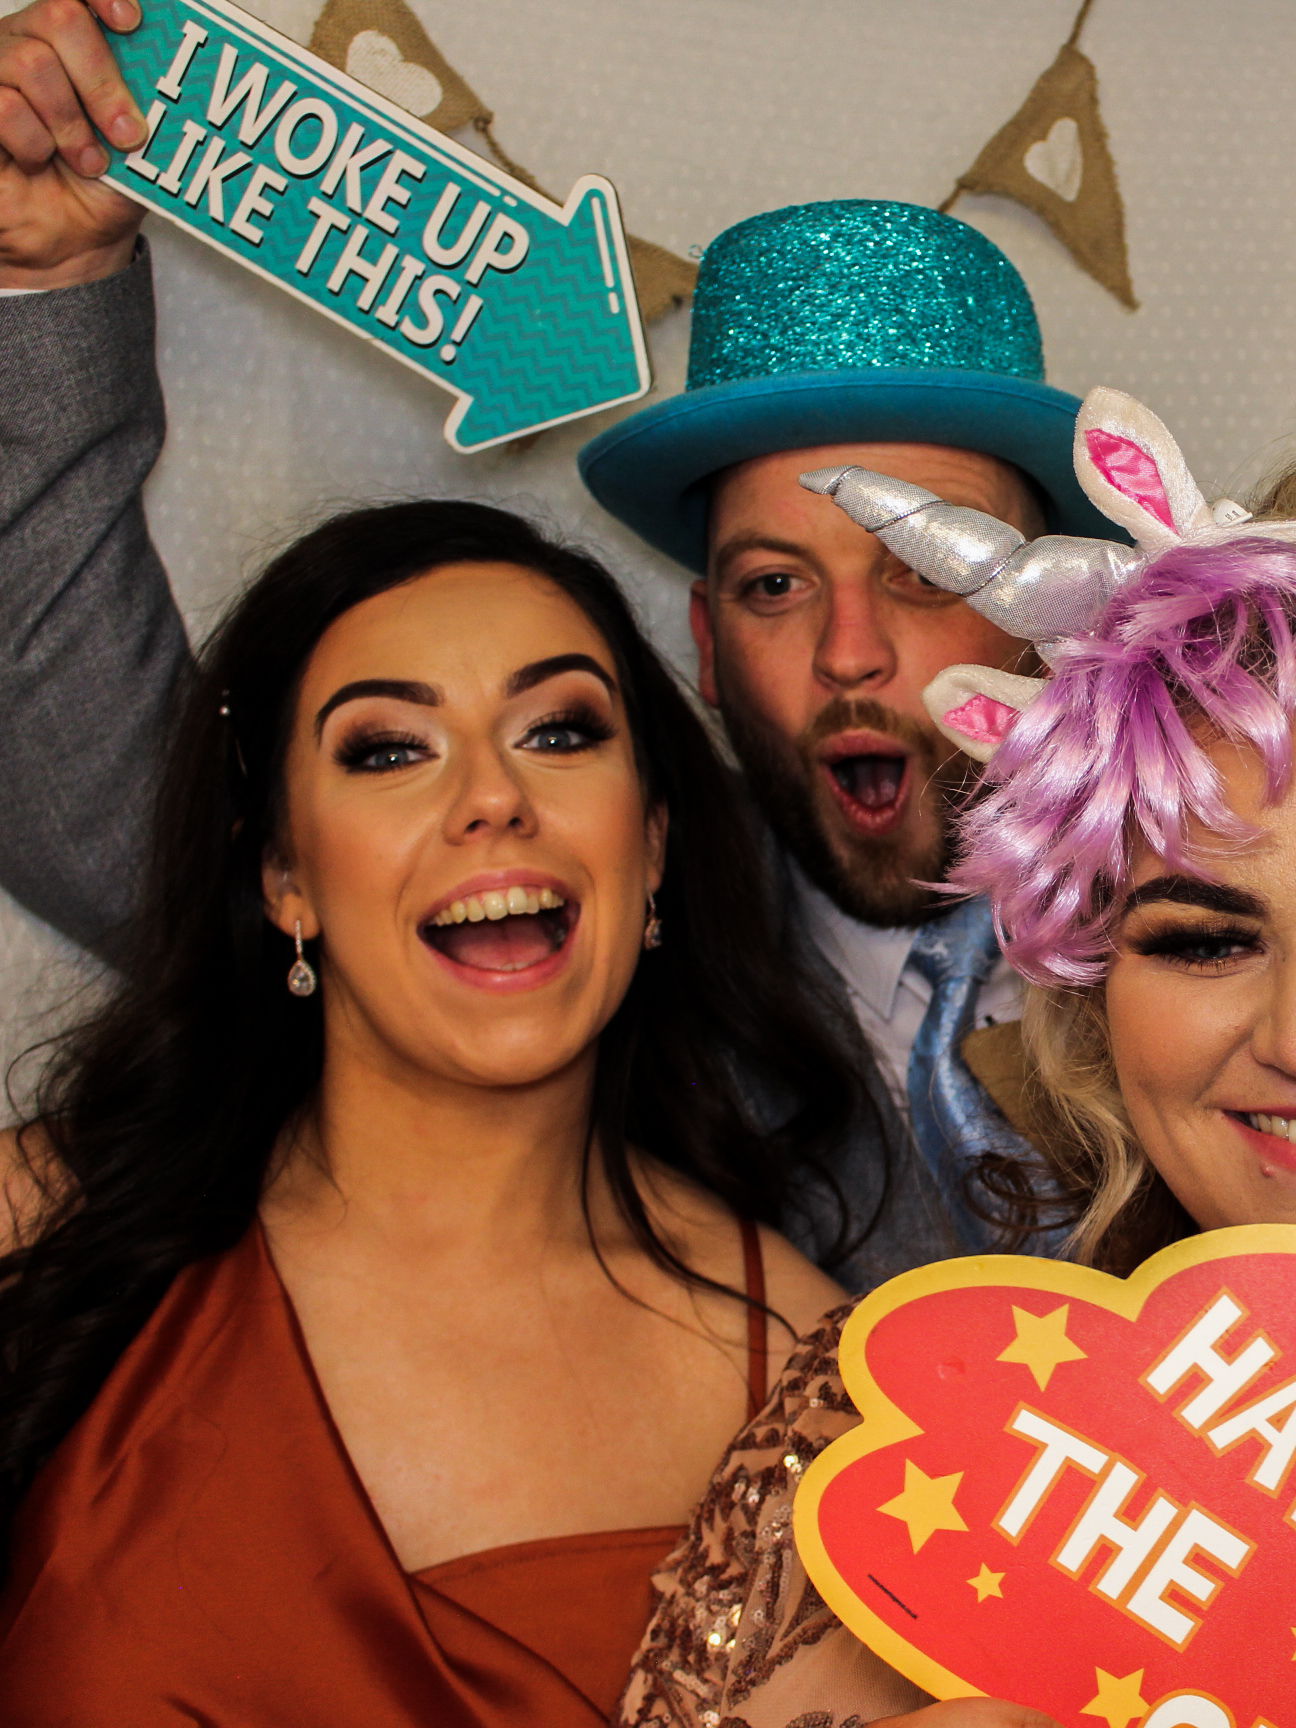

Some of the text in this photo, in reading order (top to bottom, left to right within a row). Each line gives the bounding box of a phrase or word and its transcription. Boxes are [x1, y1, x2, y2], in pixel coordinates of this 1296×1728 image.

[124, 100, 484, 364] LIKE THIS!
[156, 20, 530, 285] I WOKE UP
[995, 1405, 1252, 1647] THE
